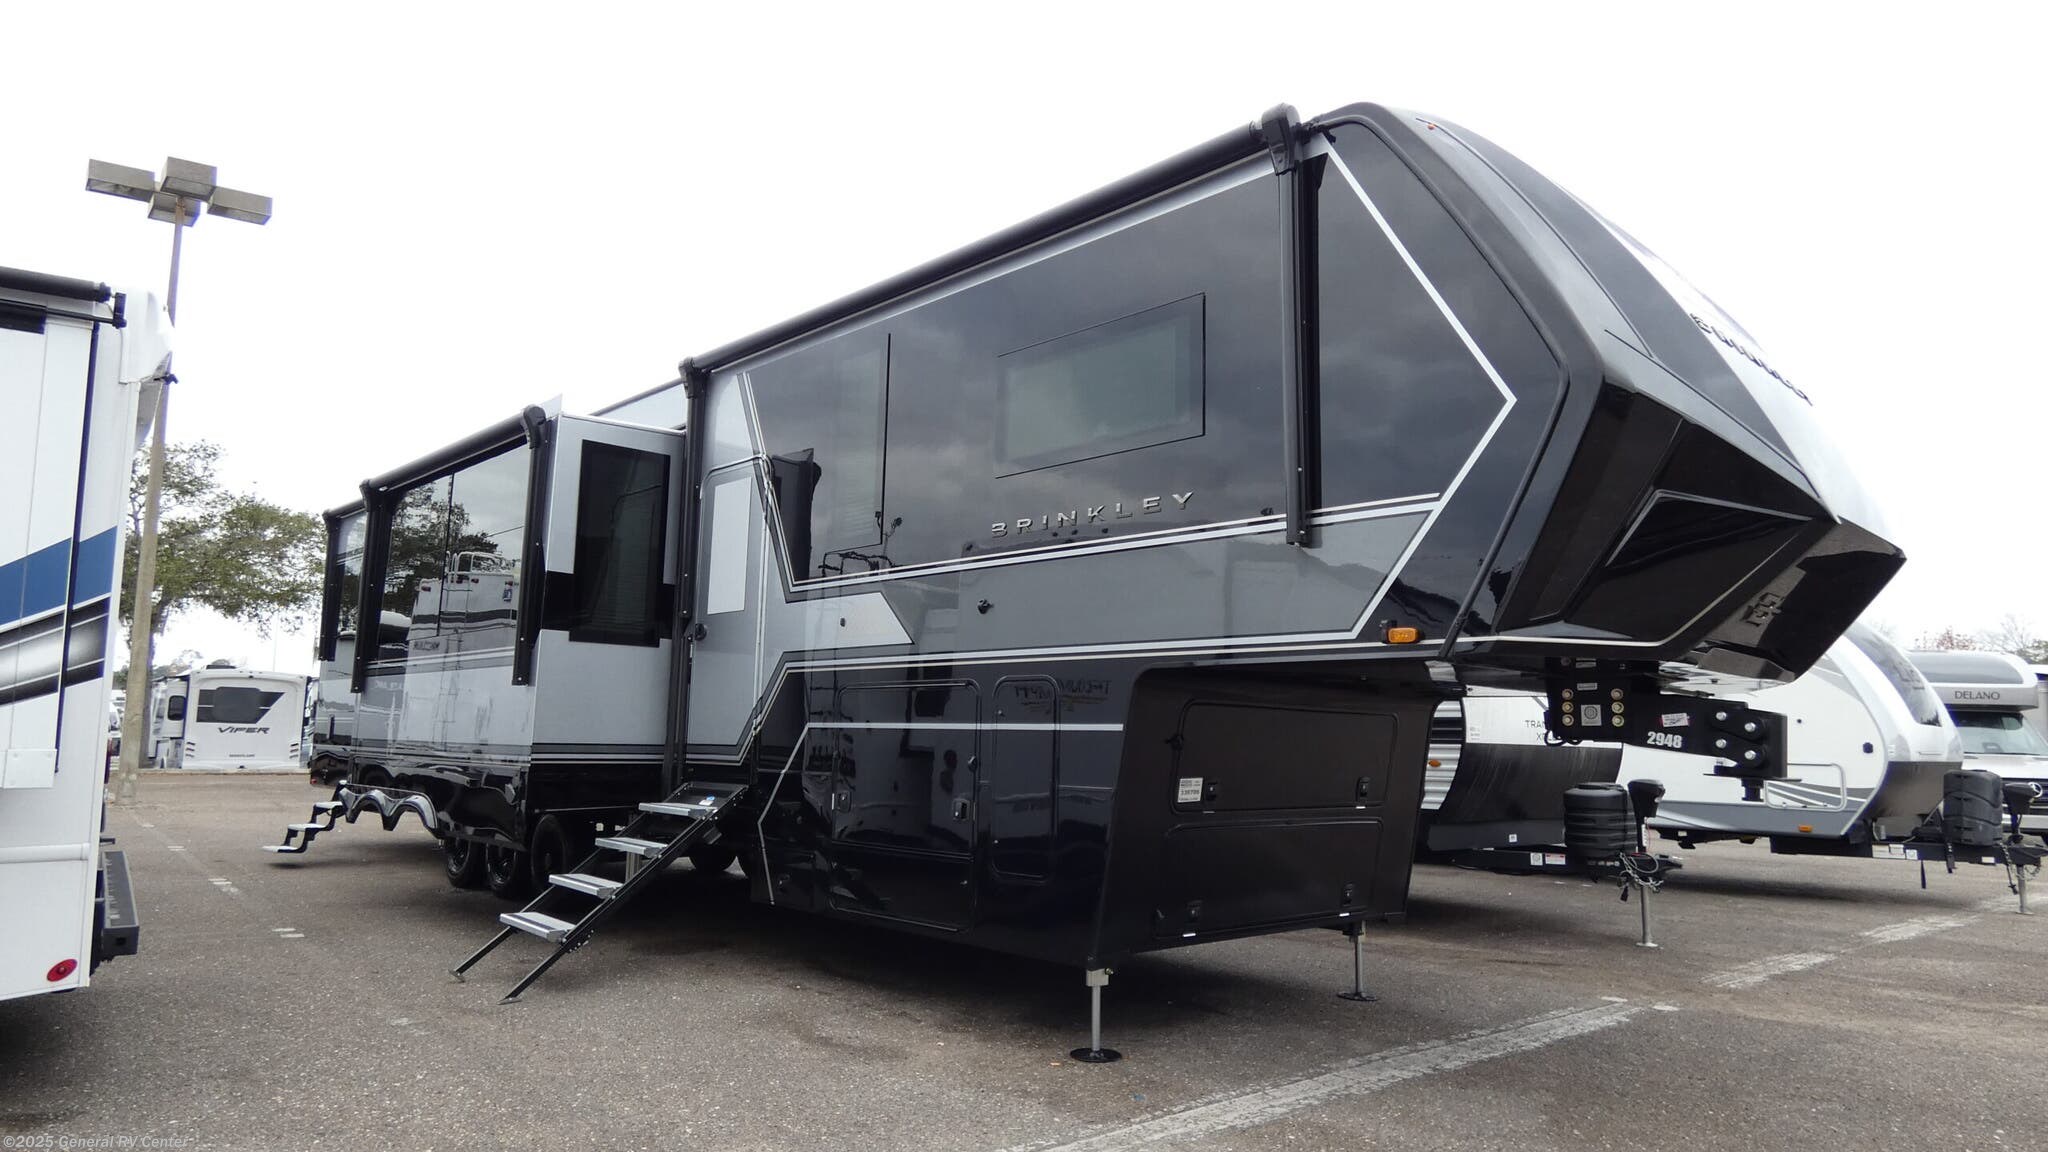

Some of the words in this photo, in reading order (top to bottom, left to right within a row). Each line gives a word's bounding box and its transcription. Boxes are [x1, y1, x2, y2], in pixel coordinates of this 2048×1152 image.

[991, 491, 1194, 538] BRINKLEY
[1954, 690, 2001, 701] DELANO
[218, 726, 270, 735] VIPER
[1646, 731, 1683, 749] 2948
